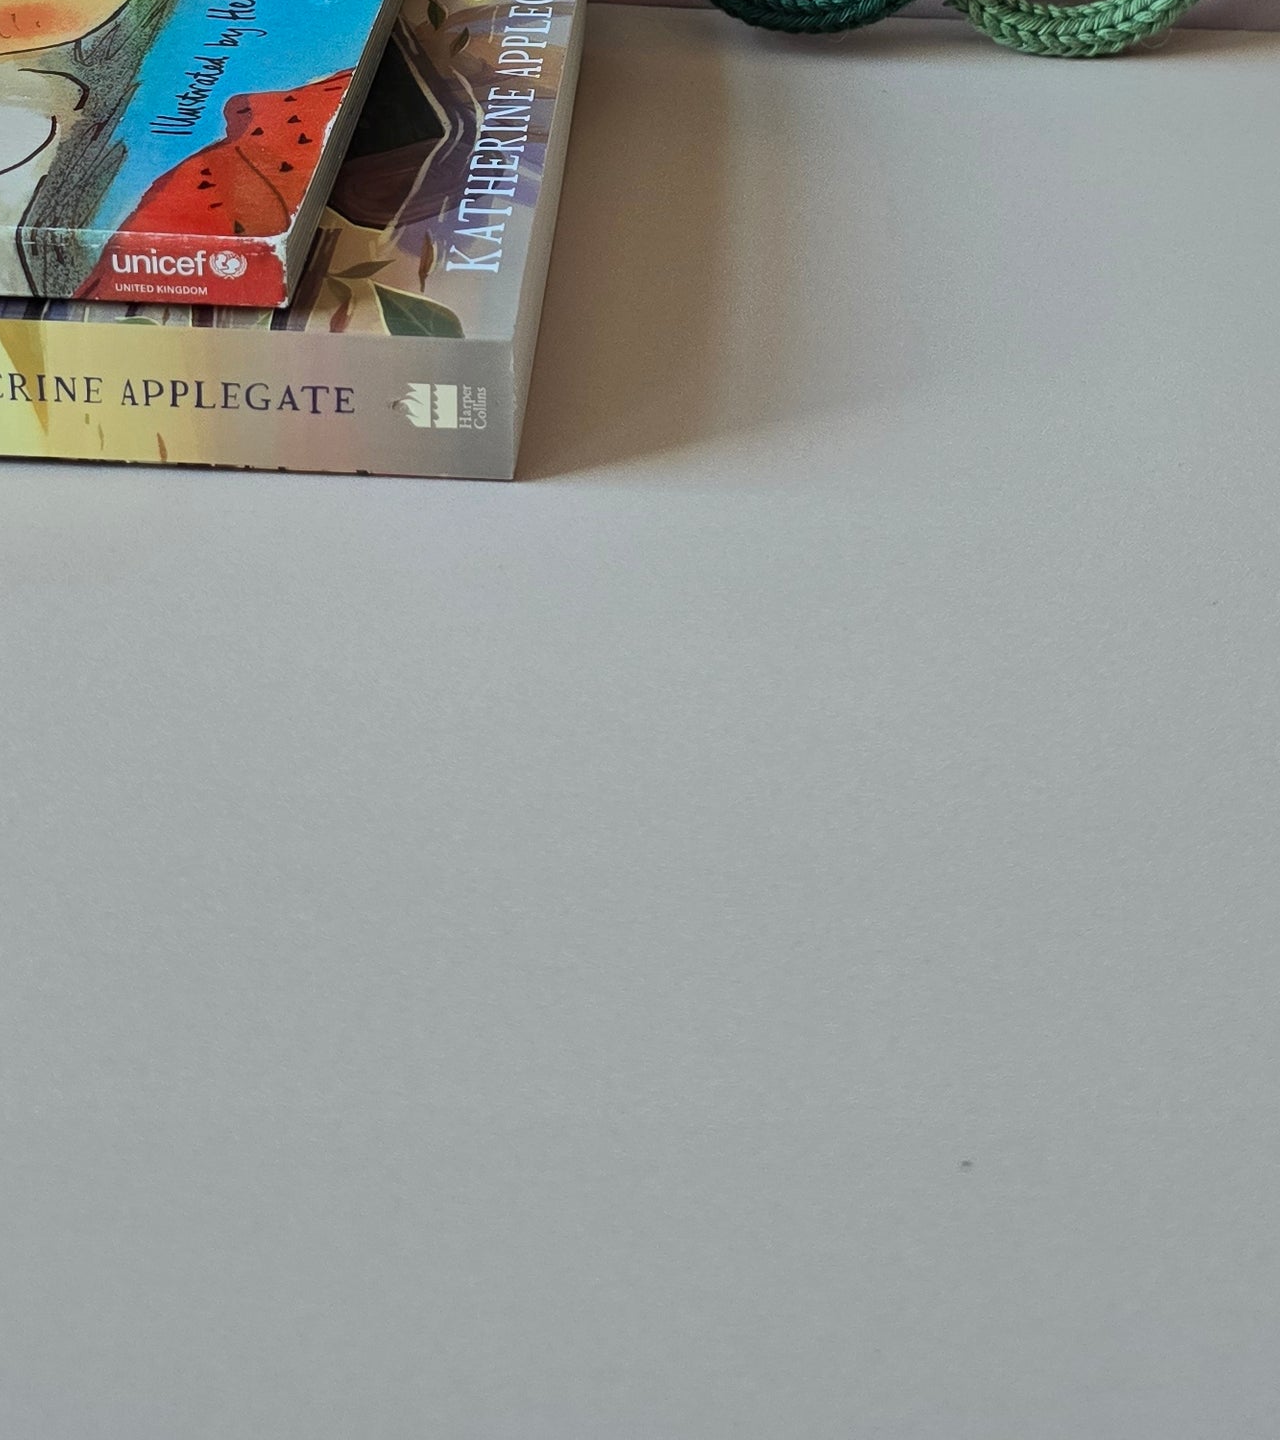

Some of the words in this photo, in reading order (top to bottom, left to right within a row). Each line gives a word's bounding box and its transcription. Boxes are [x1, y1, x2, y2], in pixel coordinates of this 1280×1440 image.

[149, 56, 230, 135] Illustrated
[204, 27, 268, 47] by
[446, 86, 535, 273] KATHERINE
[112, 248, 207, 277] unicef
[115, 283, 154, 293] UNITED
[156, 285, 208, 295] KINGDOM
[120, 378, 356, 415] APPLEGATE
[459, 384, 476, 429] Harper
[473, 387, 487, 430] Collins
